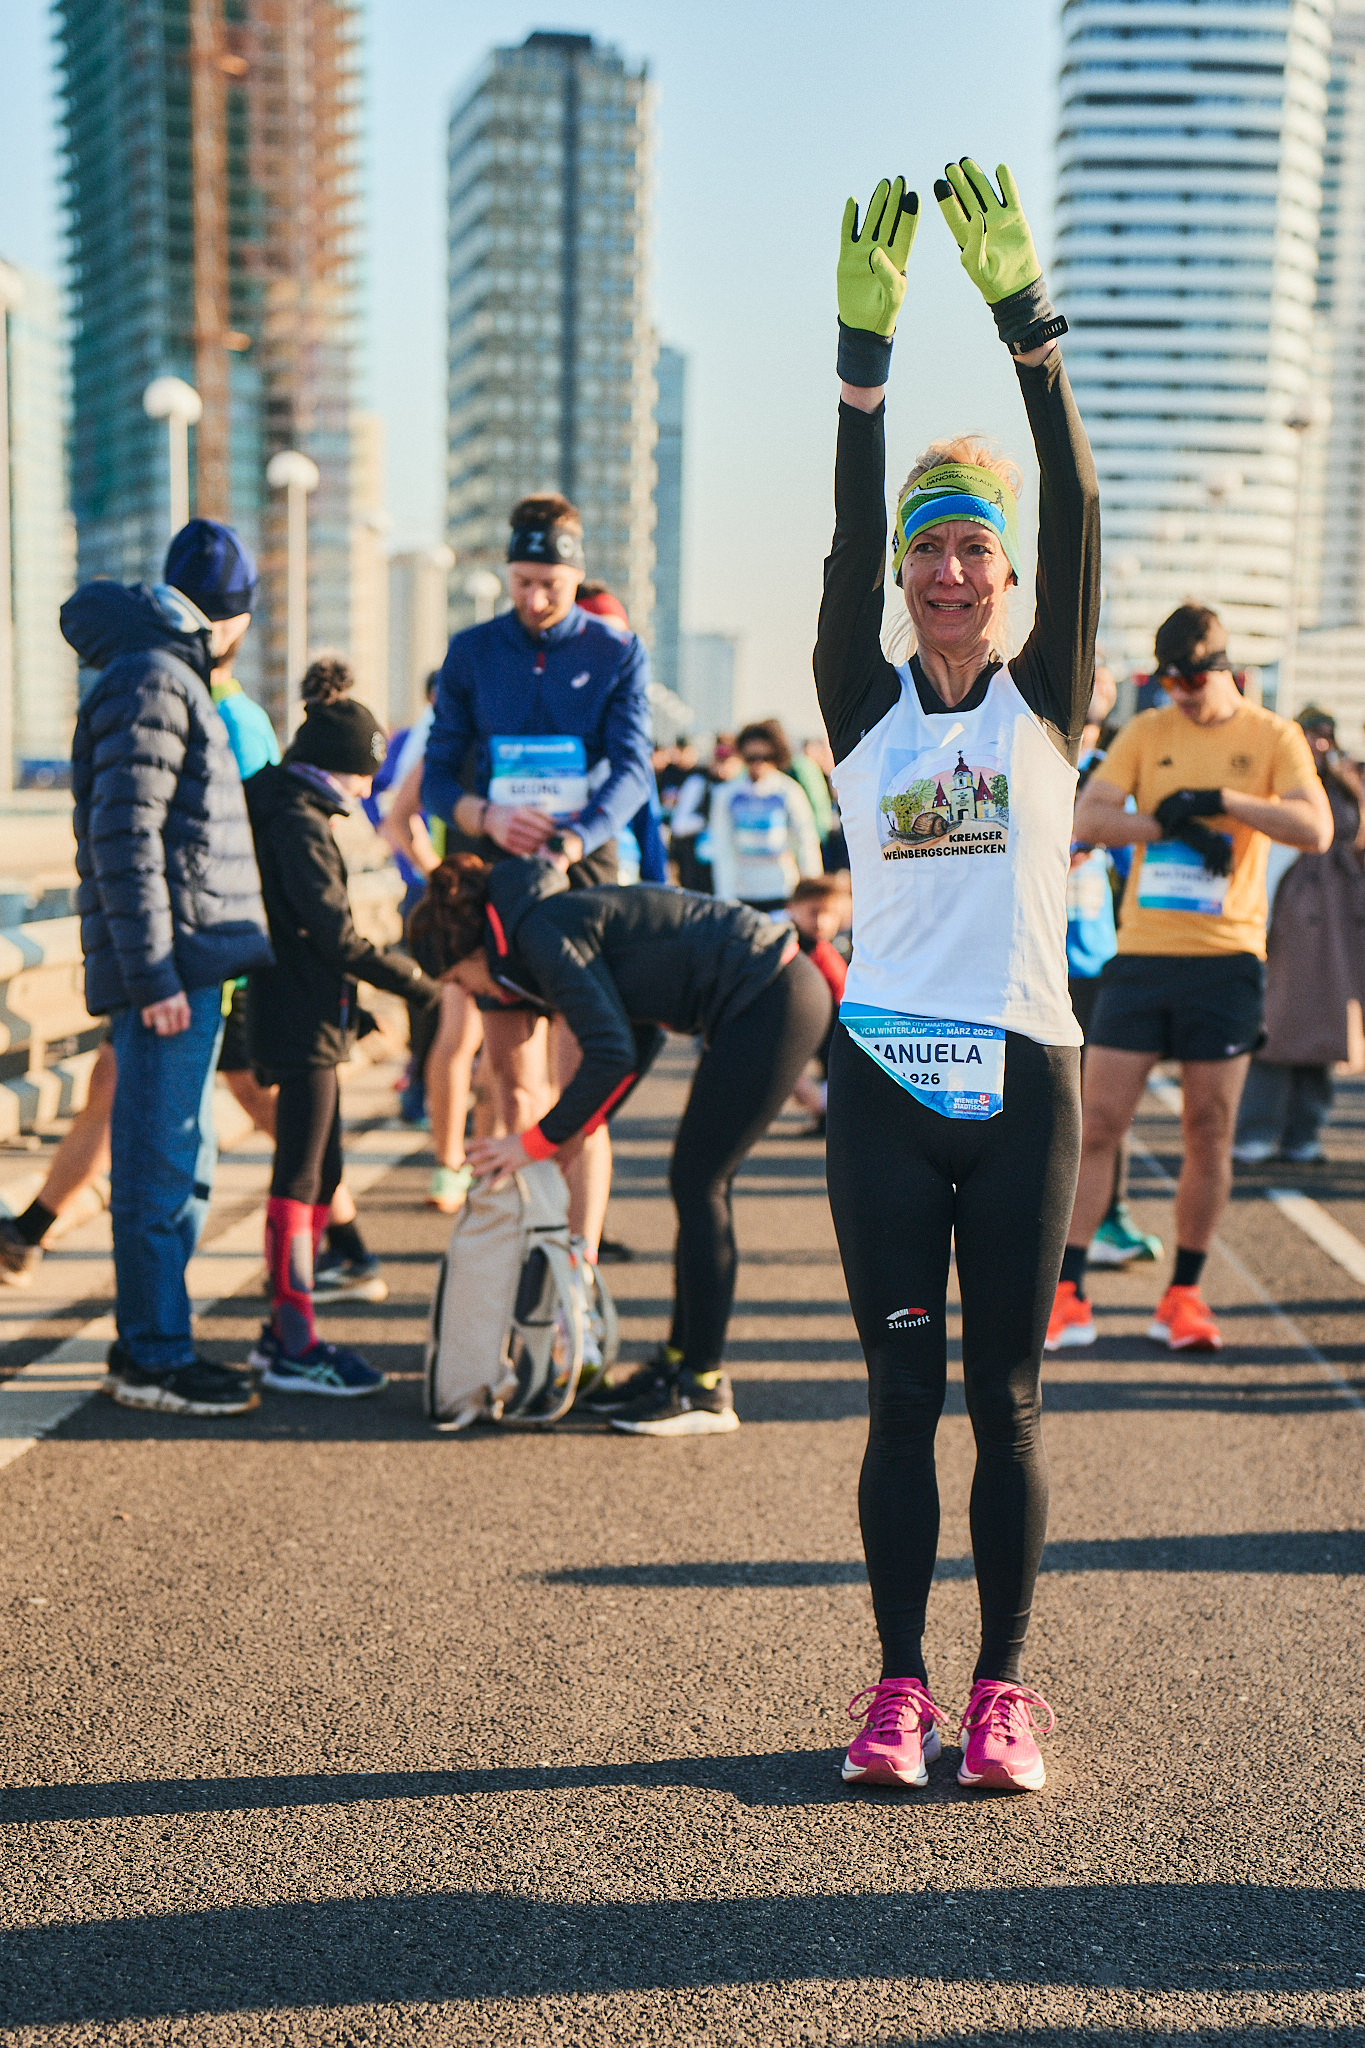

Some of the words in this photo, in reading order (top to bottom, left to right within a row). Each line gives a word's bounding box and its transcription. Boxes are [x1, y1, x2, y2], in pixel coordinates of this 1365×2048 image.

[949, 831, 1003, 843] KREMSER
[883, 844, 1006, 860] WEINBERGSCHNECKEN
[860, 1027, 876, 1035] VCM
[878, 1026, 928, 1035] WINTERLAUF
[946, 1026, 971, 1035] MÄRZ
[972, 1028, 994, 1037] 2025
[954, 1097, 979, 1105] WIENER
[888, 1315, 931, 1329] skinfit
